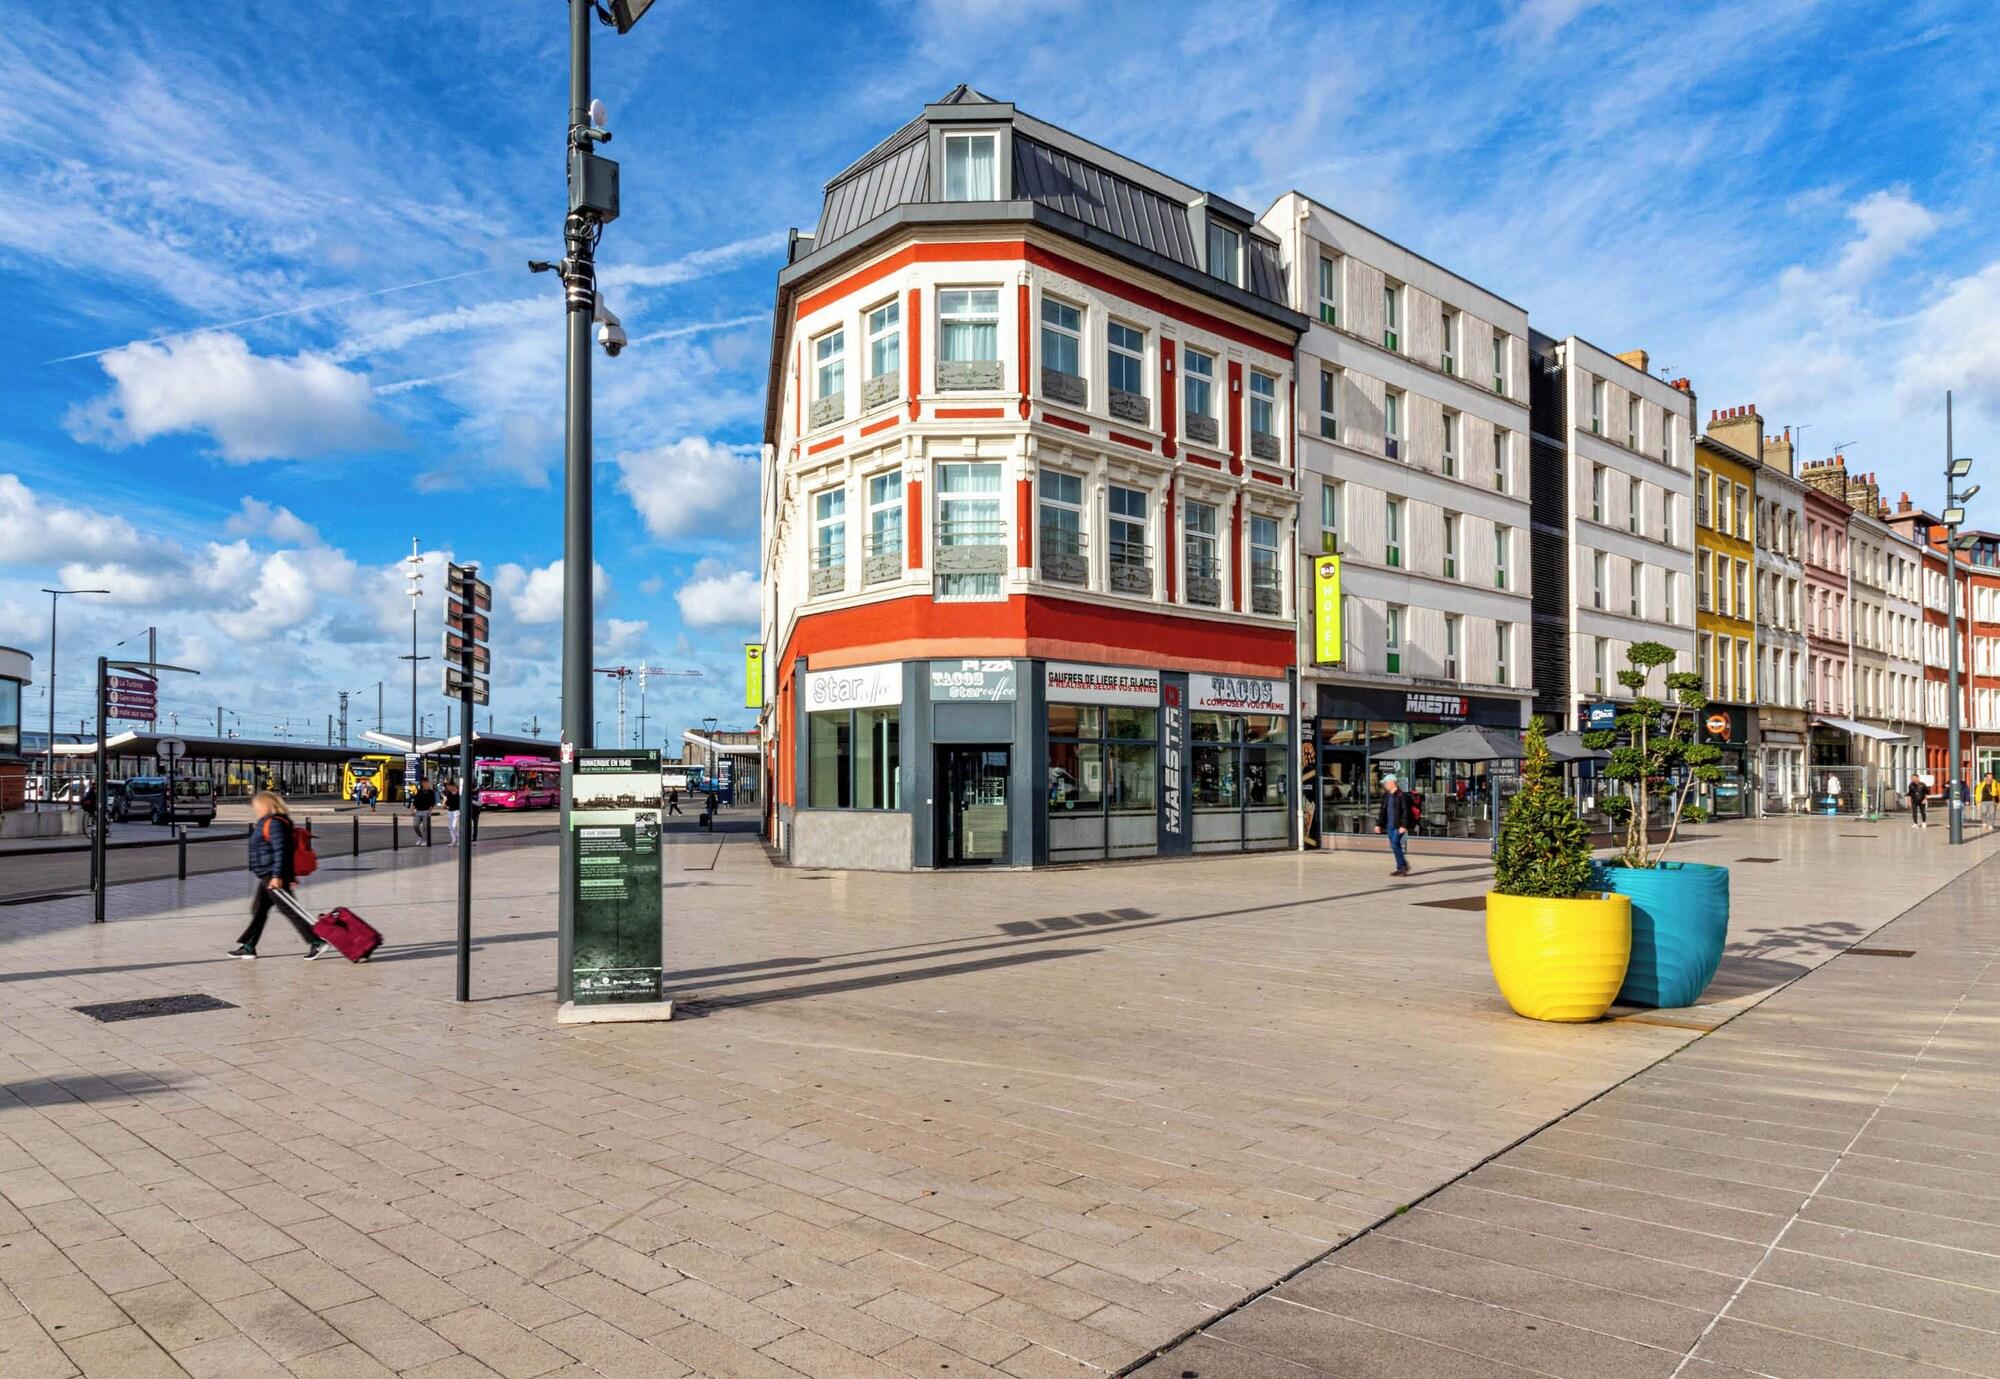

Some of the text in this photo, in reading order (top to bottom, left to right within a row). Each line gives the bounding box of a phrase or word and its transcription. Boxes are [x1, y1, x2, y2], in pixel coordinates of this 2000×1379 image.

[1323, 585, 1333, 657] HOTEL
[961, 660, 1014, 672] PIZZA
[932, 672, 984, 686] TACOS
[1048, 672, 1158, 688] GAUFRES DE LIEGE ET GLACES
[1211, 677, 1273, 704] TACOS
[1206, 698, 1245, 709] COMPOSER
[1247, 701, 1264, 710] VOUS
[1405, 693, 1470, 716] MAESTRO
[580, 759, 632, 767] DUNKERQUE EN 1940
[1164, 684, 1180, 834] MAESTRO
